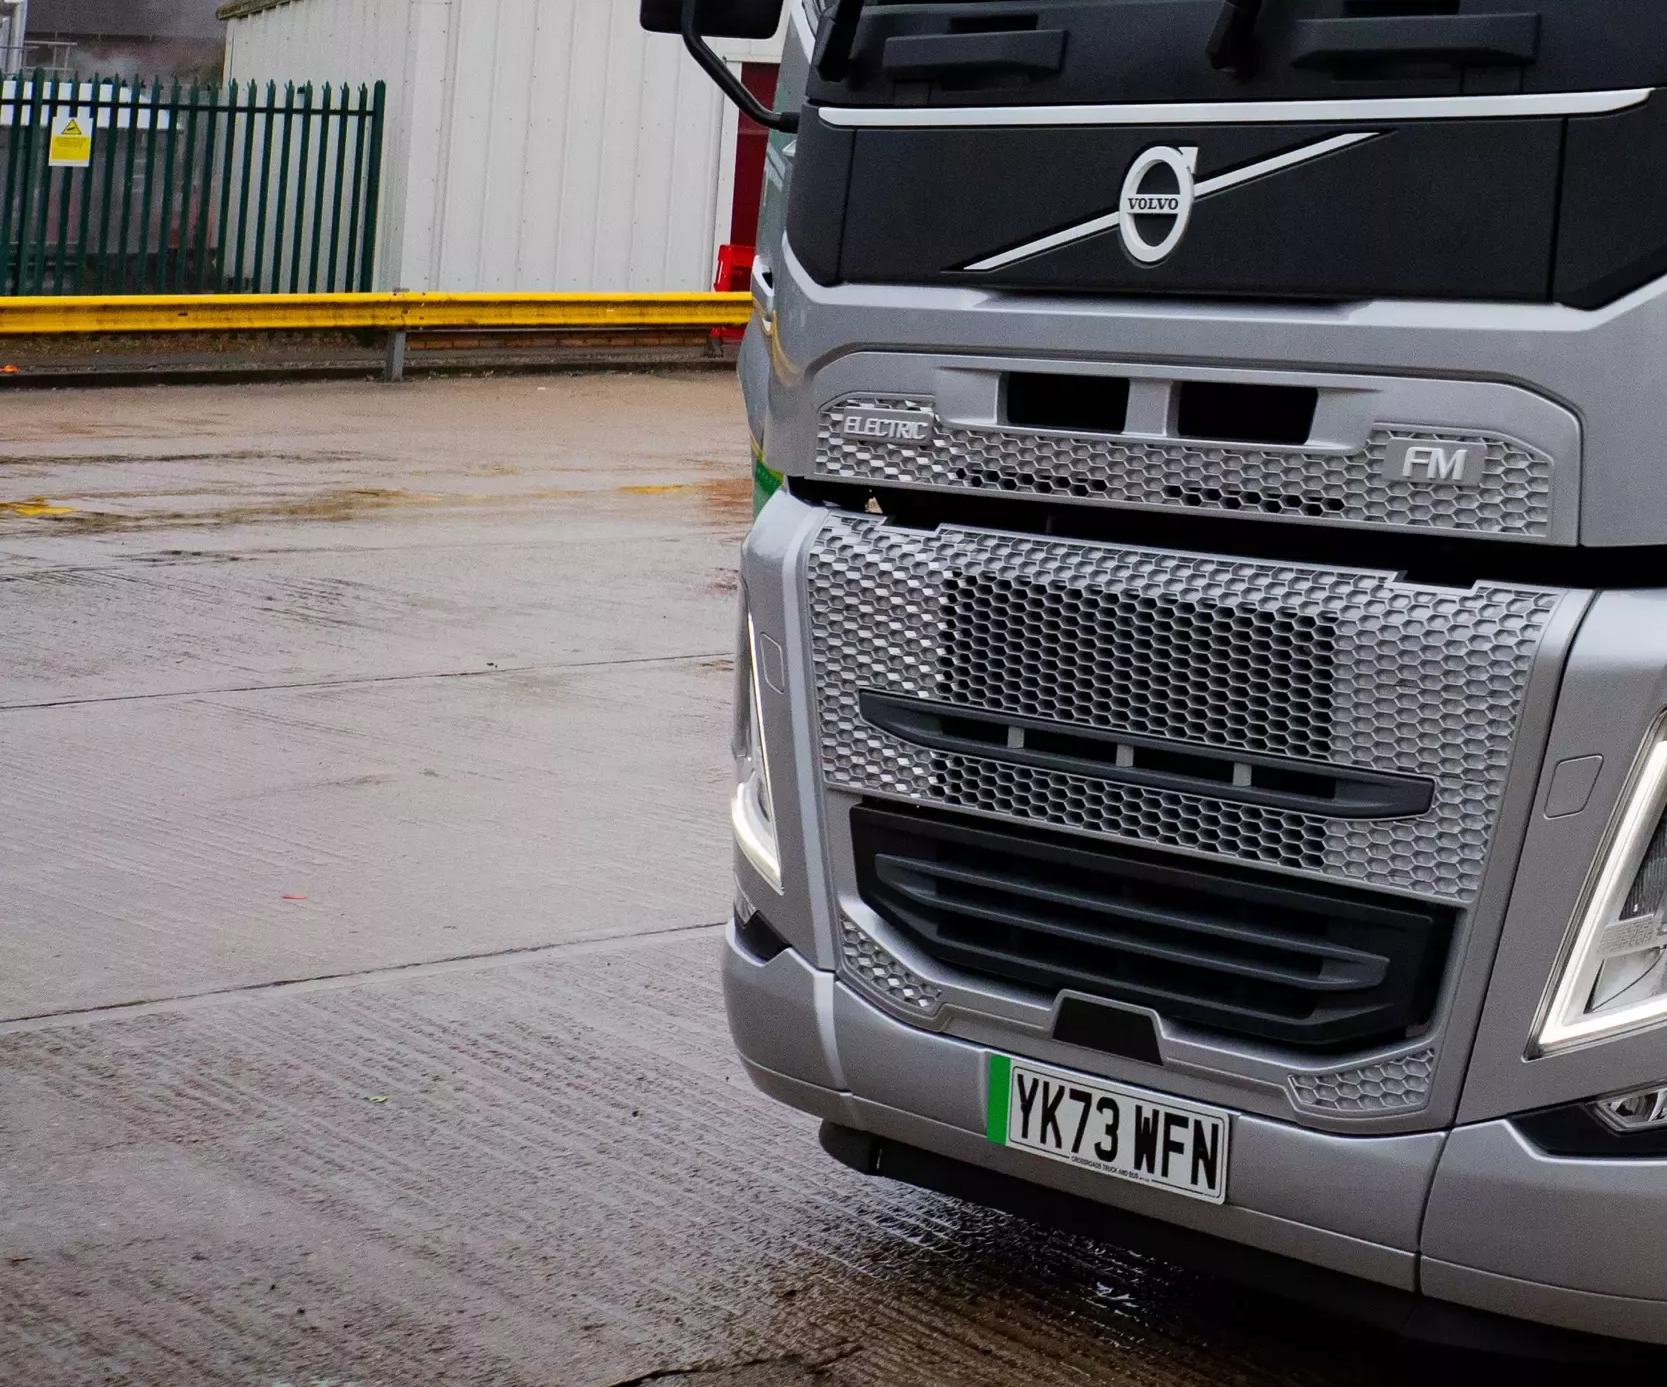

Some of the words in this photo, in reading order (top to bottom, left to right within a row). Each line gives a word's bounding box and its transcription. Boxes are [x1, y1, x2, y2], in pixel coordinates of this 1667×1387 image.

[1127, 197, 1179, 211] VOLVO
[843, 416, 929, 440] ELECTRIC
[1402, 446, 1468, 481] FM
[1016, 1073, 1121, 1163] YK73
[1133, 1103, 1220, 1191] WFN
